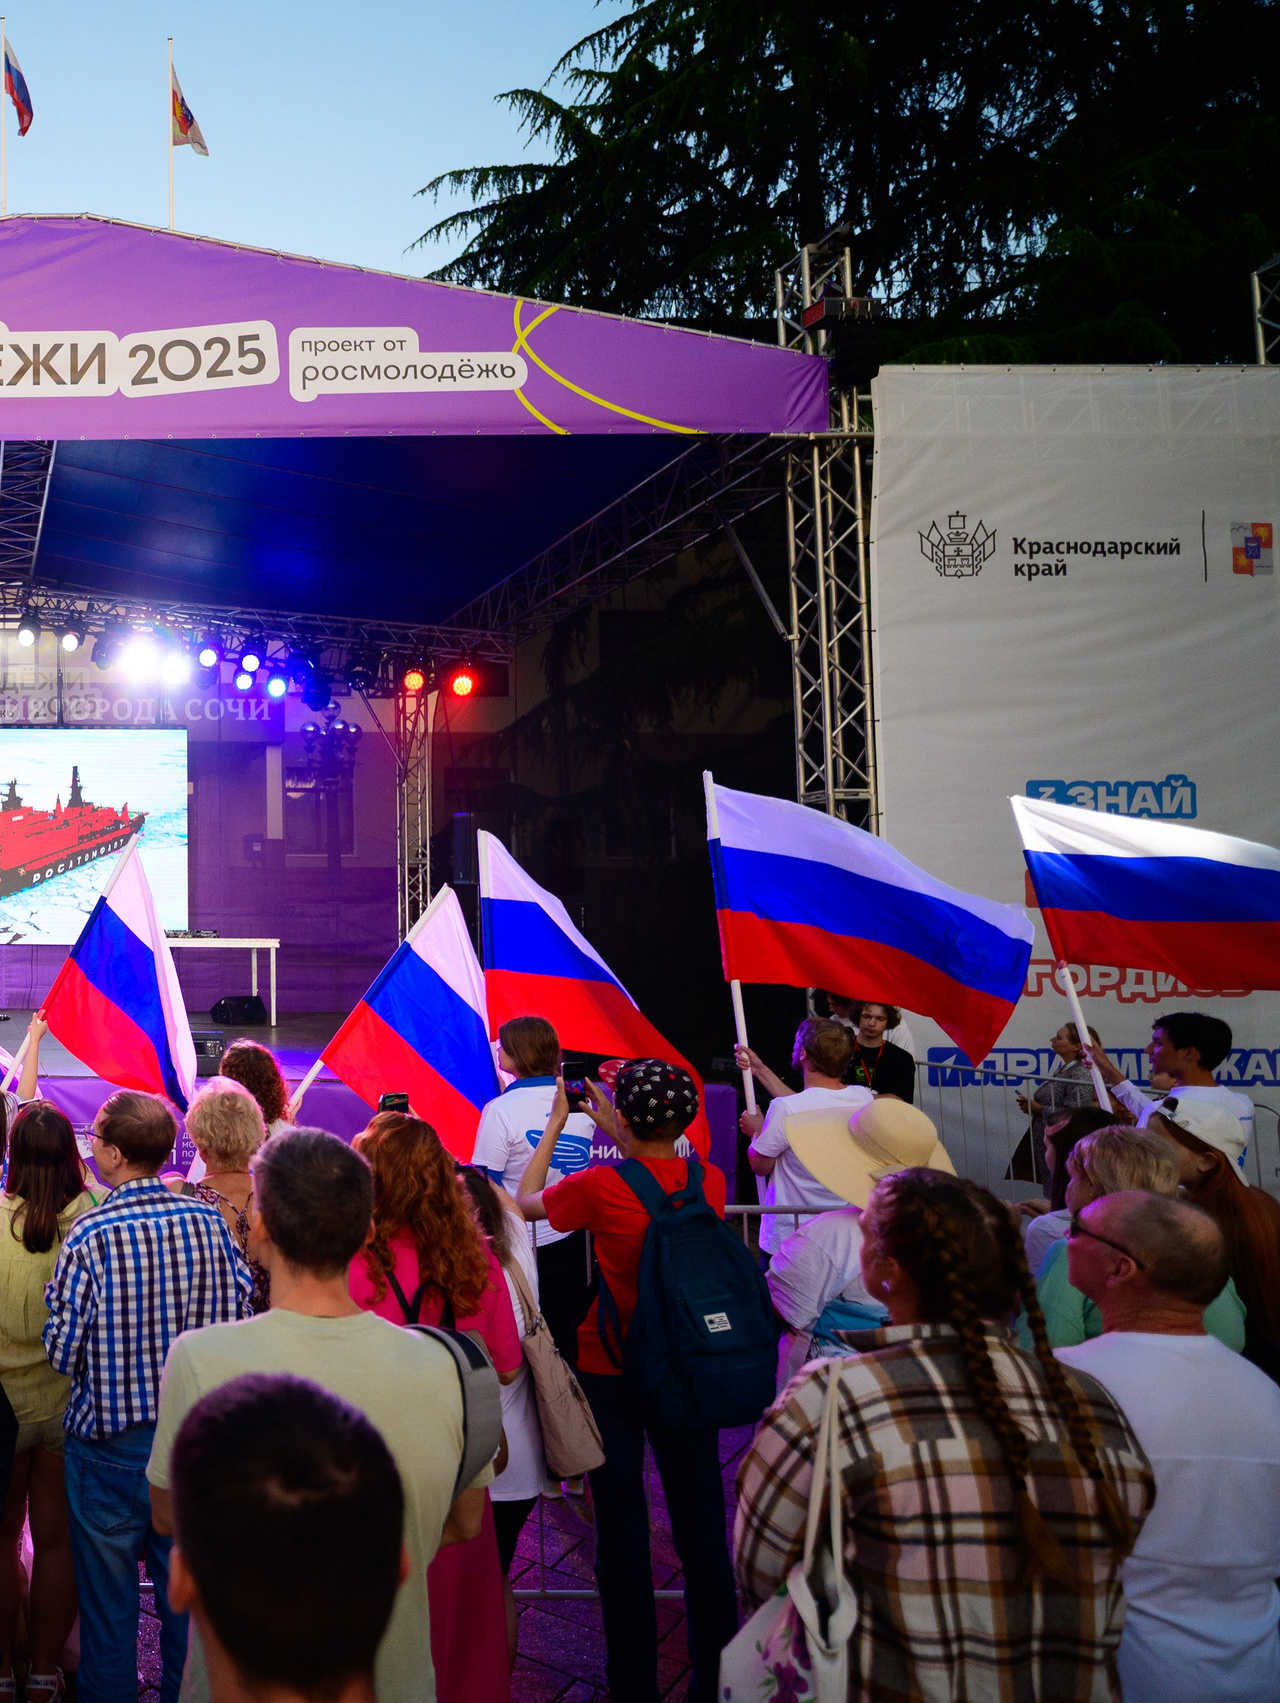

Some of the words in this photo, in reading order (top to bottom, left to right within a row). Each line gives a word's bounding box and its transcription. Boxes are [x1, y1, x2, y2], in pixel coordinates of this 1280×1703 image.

[301, 339, 376, 356] проект
[383, 339, 407, 352] от
[128, 333, 267, 387] 2025
[302, 358, 517, 390] росмолодёжь
[1012, 537, 1181, 560] Краснодарский
[1013, 559, 1068, 581] край
[184, 698, 272, 721] СОЧИ
[1027, 964, 1244, 998] ГОРДИ
